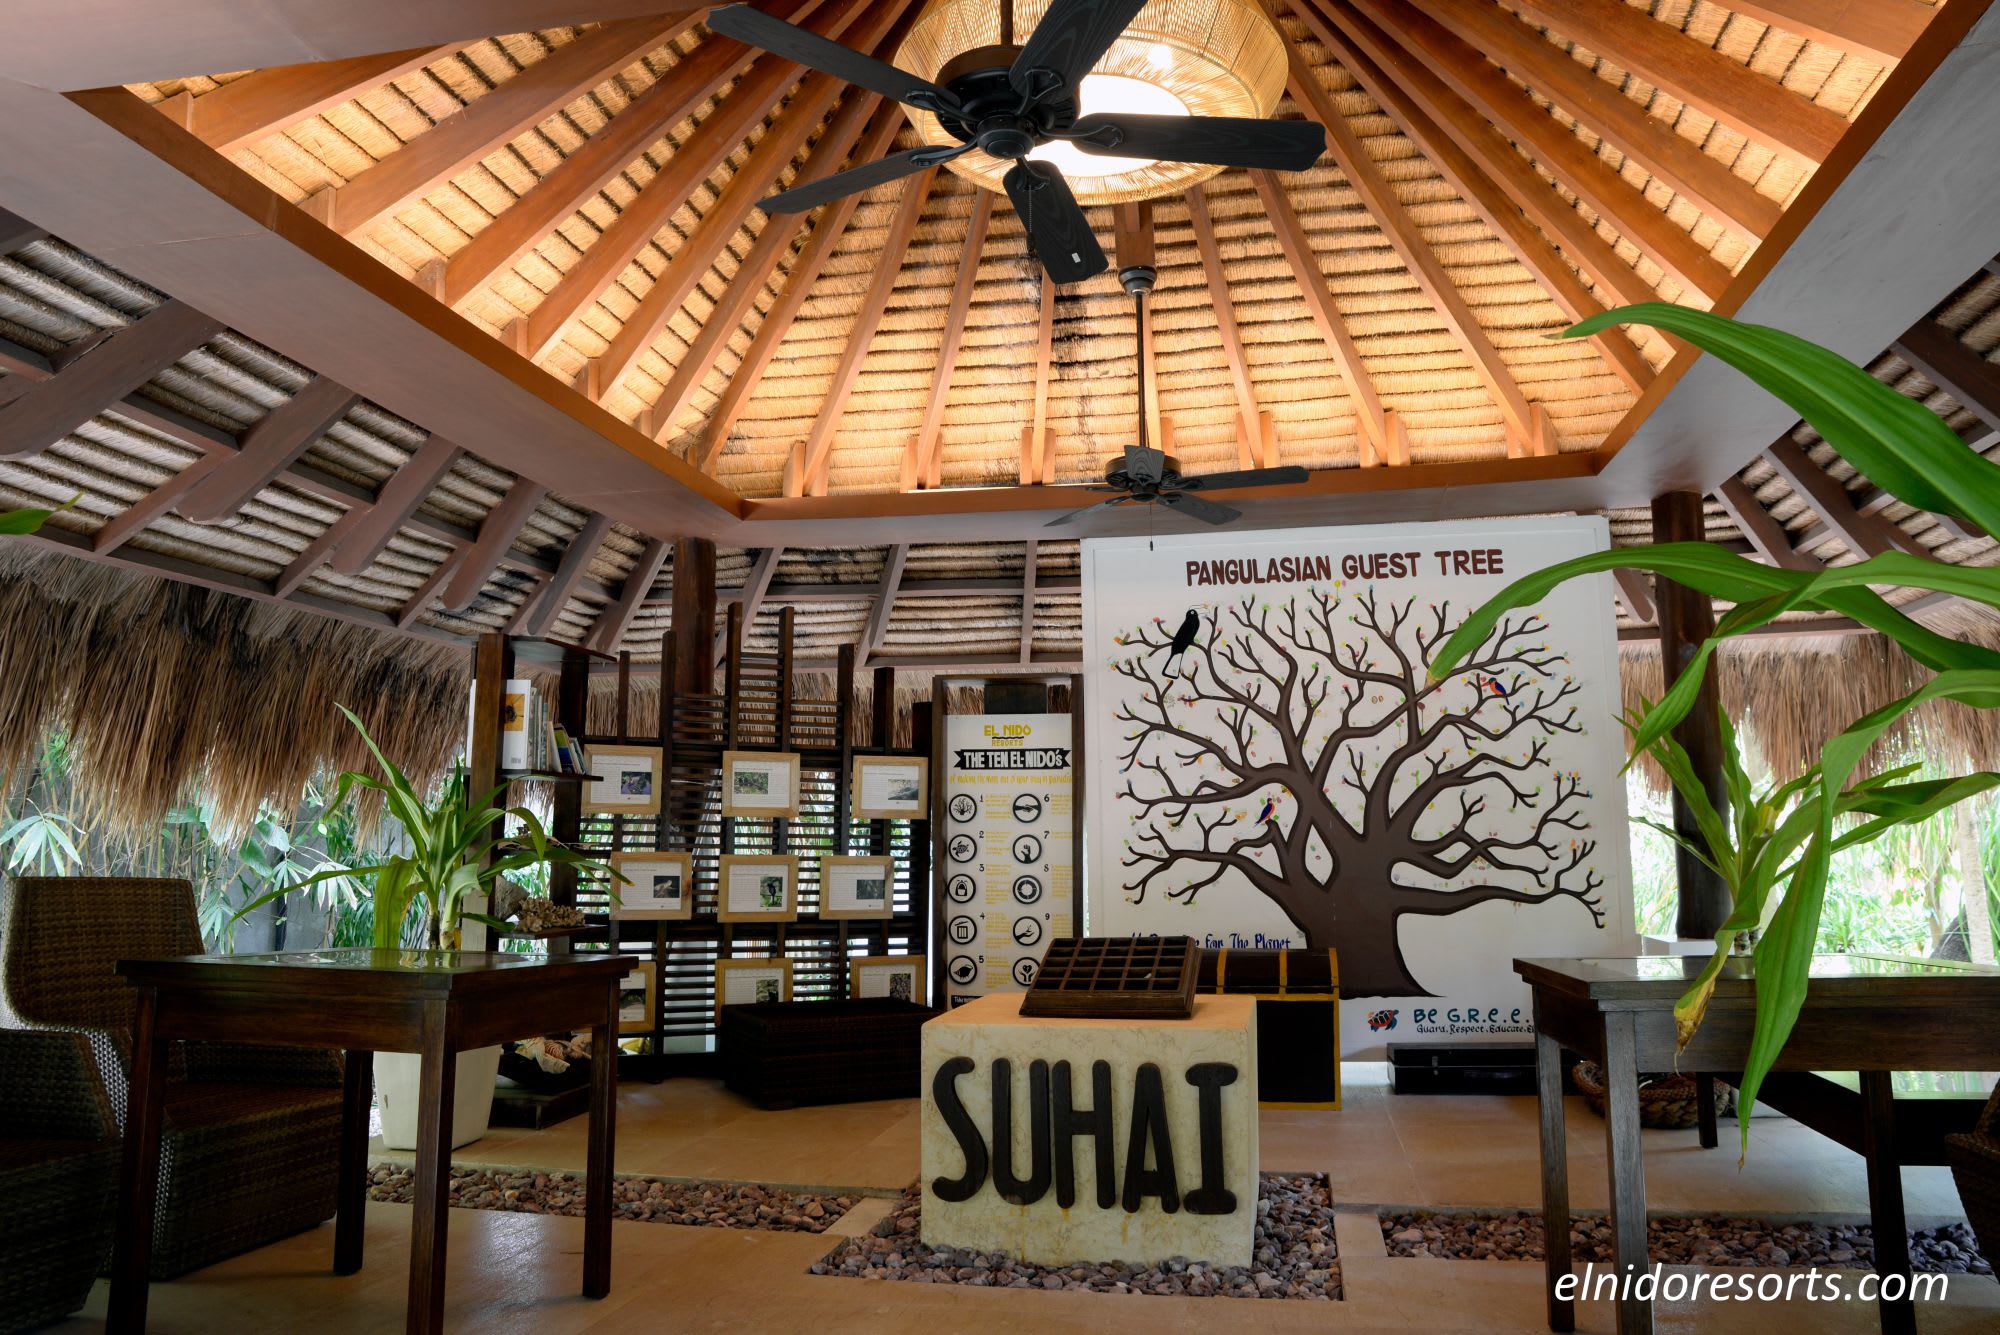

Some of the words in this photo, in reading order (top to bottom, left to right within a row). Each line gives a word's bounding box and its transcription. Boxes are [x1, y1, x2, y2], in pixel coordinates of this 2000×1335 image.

[1186, 555, 1332, 587] PANGULASIAN
[1341, 551, 1421, 580] GUEST
[1434, 548, 1504, 576] TREE
[984, 725, 999, 736] EL
[1003, 724, 1031, 736] NIDO
[963, 751, 985, 768] THE
[986, 751, 1009, 768] TEN
[979, 794, 984, 803] 1
[1044, 794, 1050, 802] 6
[979, 831, 984, 839] 2
[1044, 831, 1050, 839] 7
[979, 864, 985, 872] 3
[980, 912, 985, 920] 4
[1229, 933, 1248, 948] The
[1255, 933, 1291, 949] Planet
[931, 1056, 1239, 1215] SUHAI
